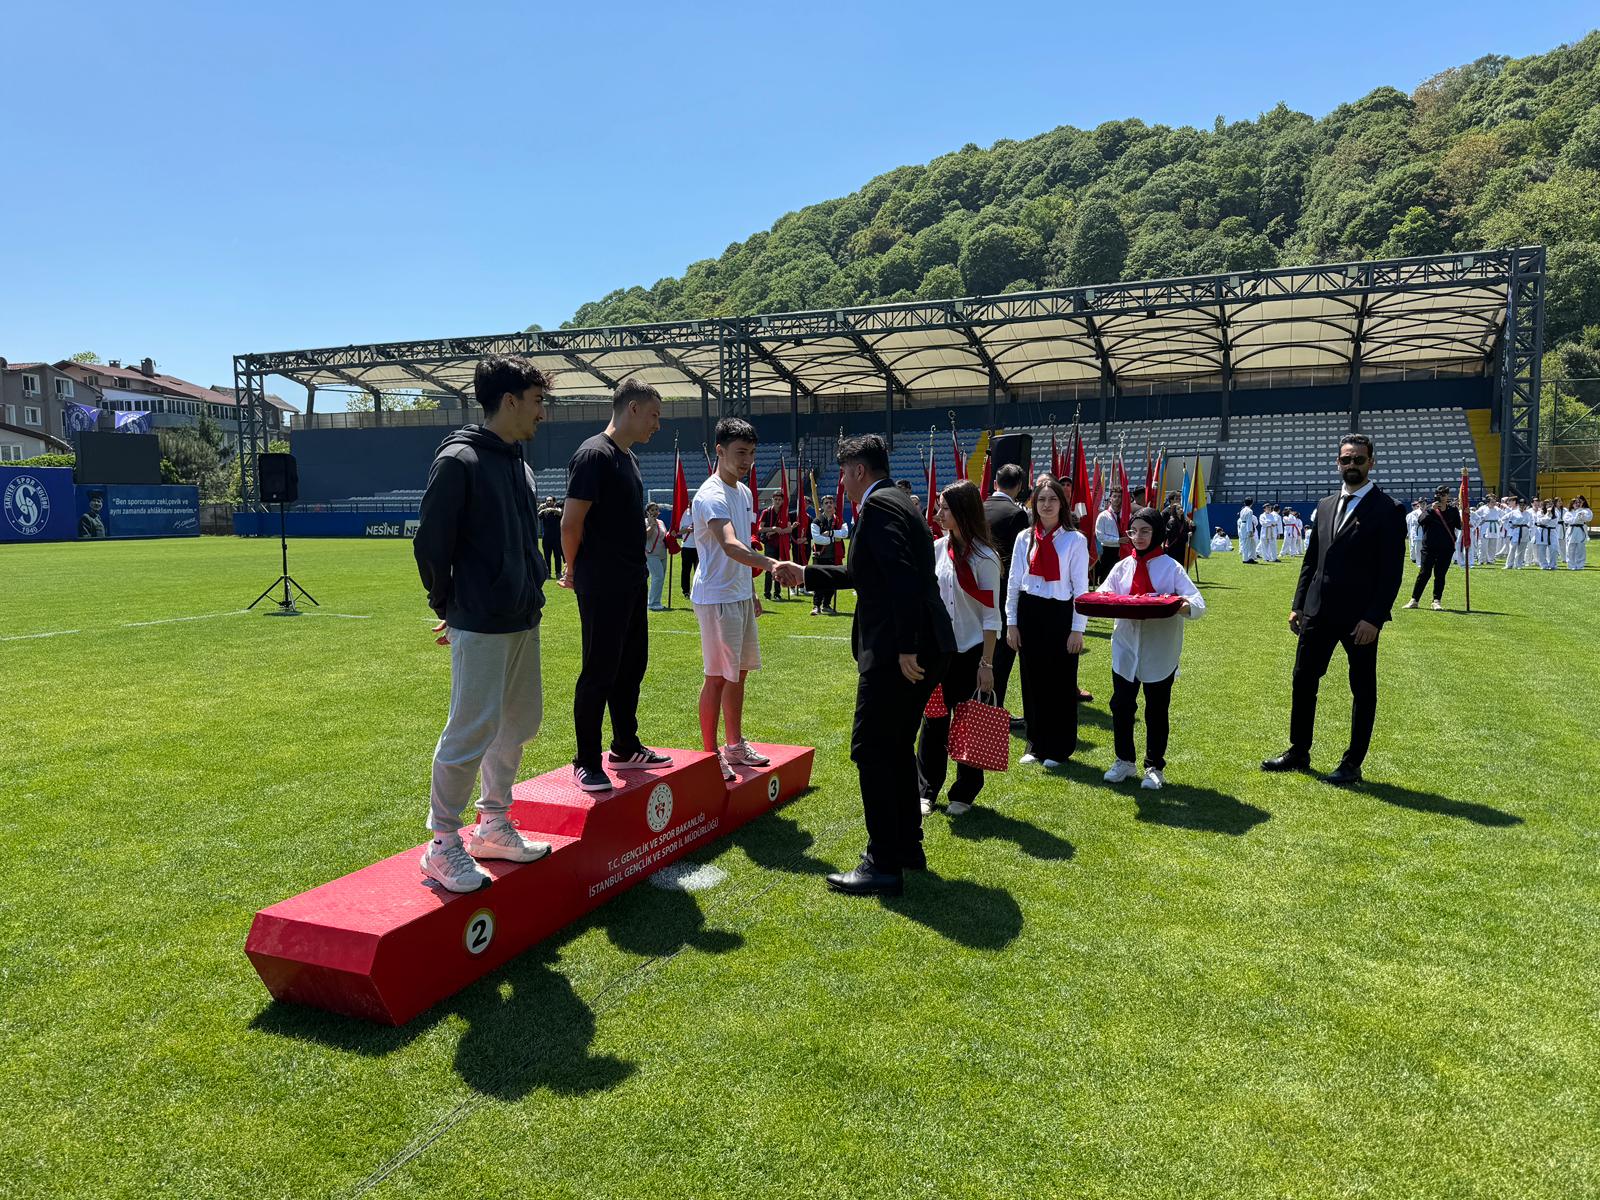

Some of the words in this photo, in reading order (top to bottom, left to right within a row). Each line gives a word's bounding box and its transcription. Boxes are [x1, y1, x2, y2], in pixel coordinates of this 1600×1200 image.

[16, 477, 36, 486] SPOR
[22, 526, 38, 534] 1940
[770, 779, 778, 798] 3
[607, 857, 620, 872] T.C.
[620, 842, 649, 864] GENÇLİK
[649, 837, 658, 849] VE
[658, 828, 675, 845] SPOR
[675, 811, 706, 836] BAKANLIĞI
[588, 871, 624, 898] İSTANBUL
[624, 854, 652, 878] GENÇLİK
[652, 849, 661, 862] VE
[661, 841, 678, 858] SPOR
[678, 837, 684, 848] İL
[684, 816, 719, 845] MÜDÜRLÜĞÜ
[471, 919, 488, 949] 2
